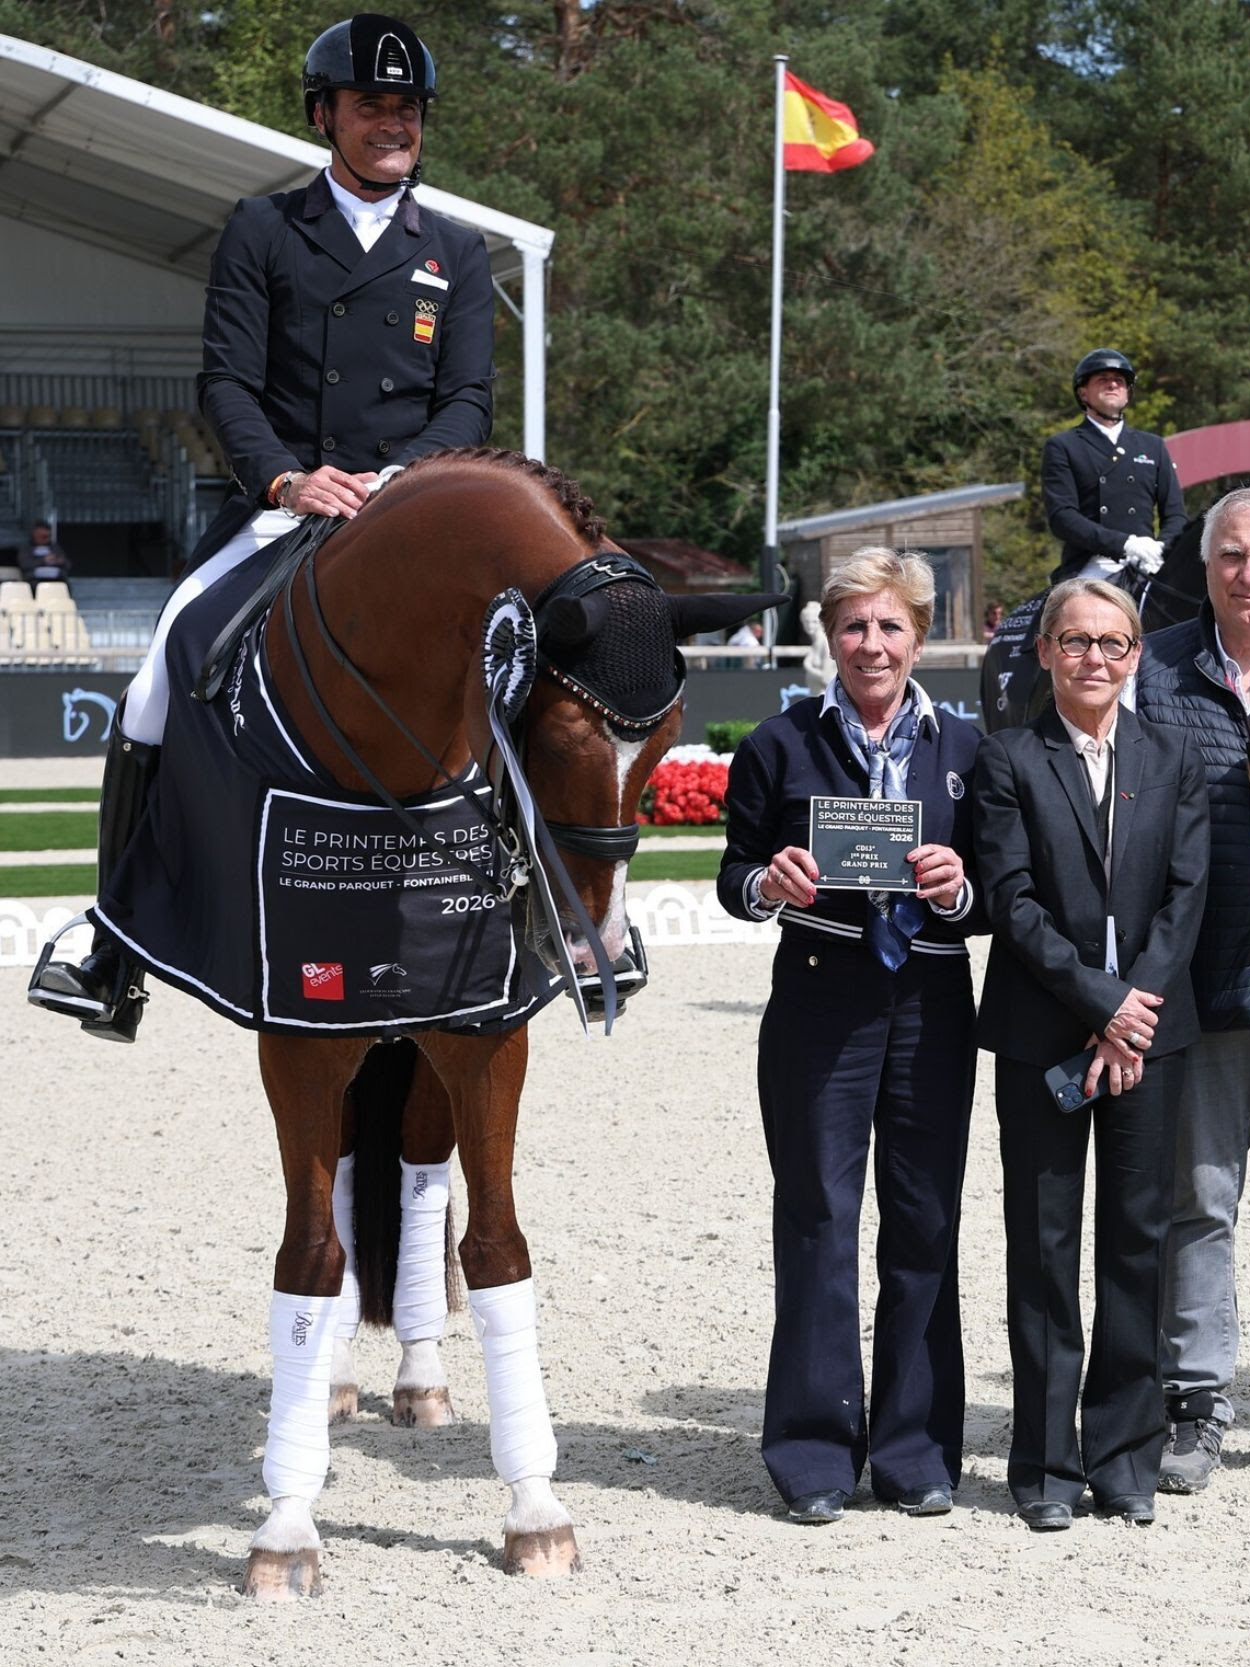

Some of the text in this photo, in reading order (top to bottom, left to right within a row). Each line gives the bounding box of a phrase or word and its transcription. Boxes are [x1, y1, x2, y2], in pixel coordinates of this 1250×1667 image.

[818, 801, 914, 813] LE PRINTEMPS DES
[818, 811, 914, 824] SPORTS ÉQUESTRES
[284, 827, 307, 845] LE
[453, 824, 489, 844] DES
[889, 832, 914, 842] 2026
[281, 844, 493, 872] SPORTS ÉQUESRES
[841, 860, 888, 869] GRAND PRIX
[279, 876, 292, 887] LE
[294, 879, 336, 891] GRAND
[339, 880, 394, 892] PARQUET
[403, 869, 494, 888] FONTAINEBL
[441, 893, 496, 915] 2026
[302, 963, 326, 978] GL
[310, 964, 344, 987] events
